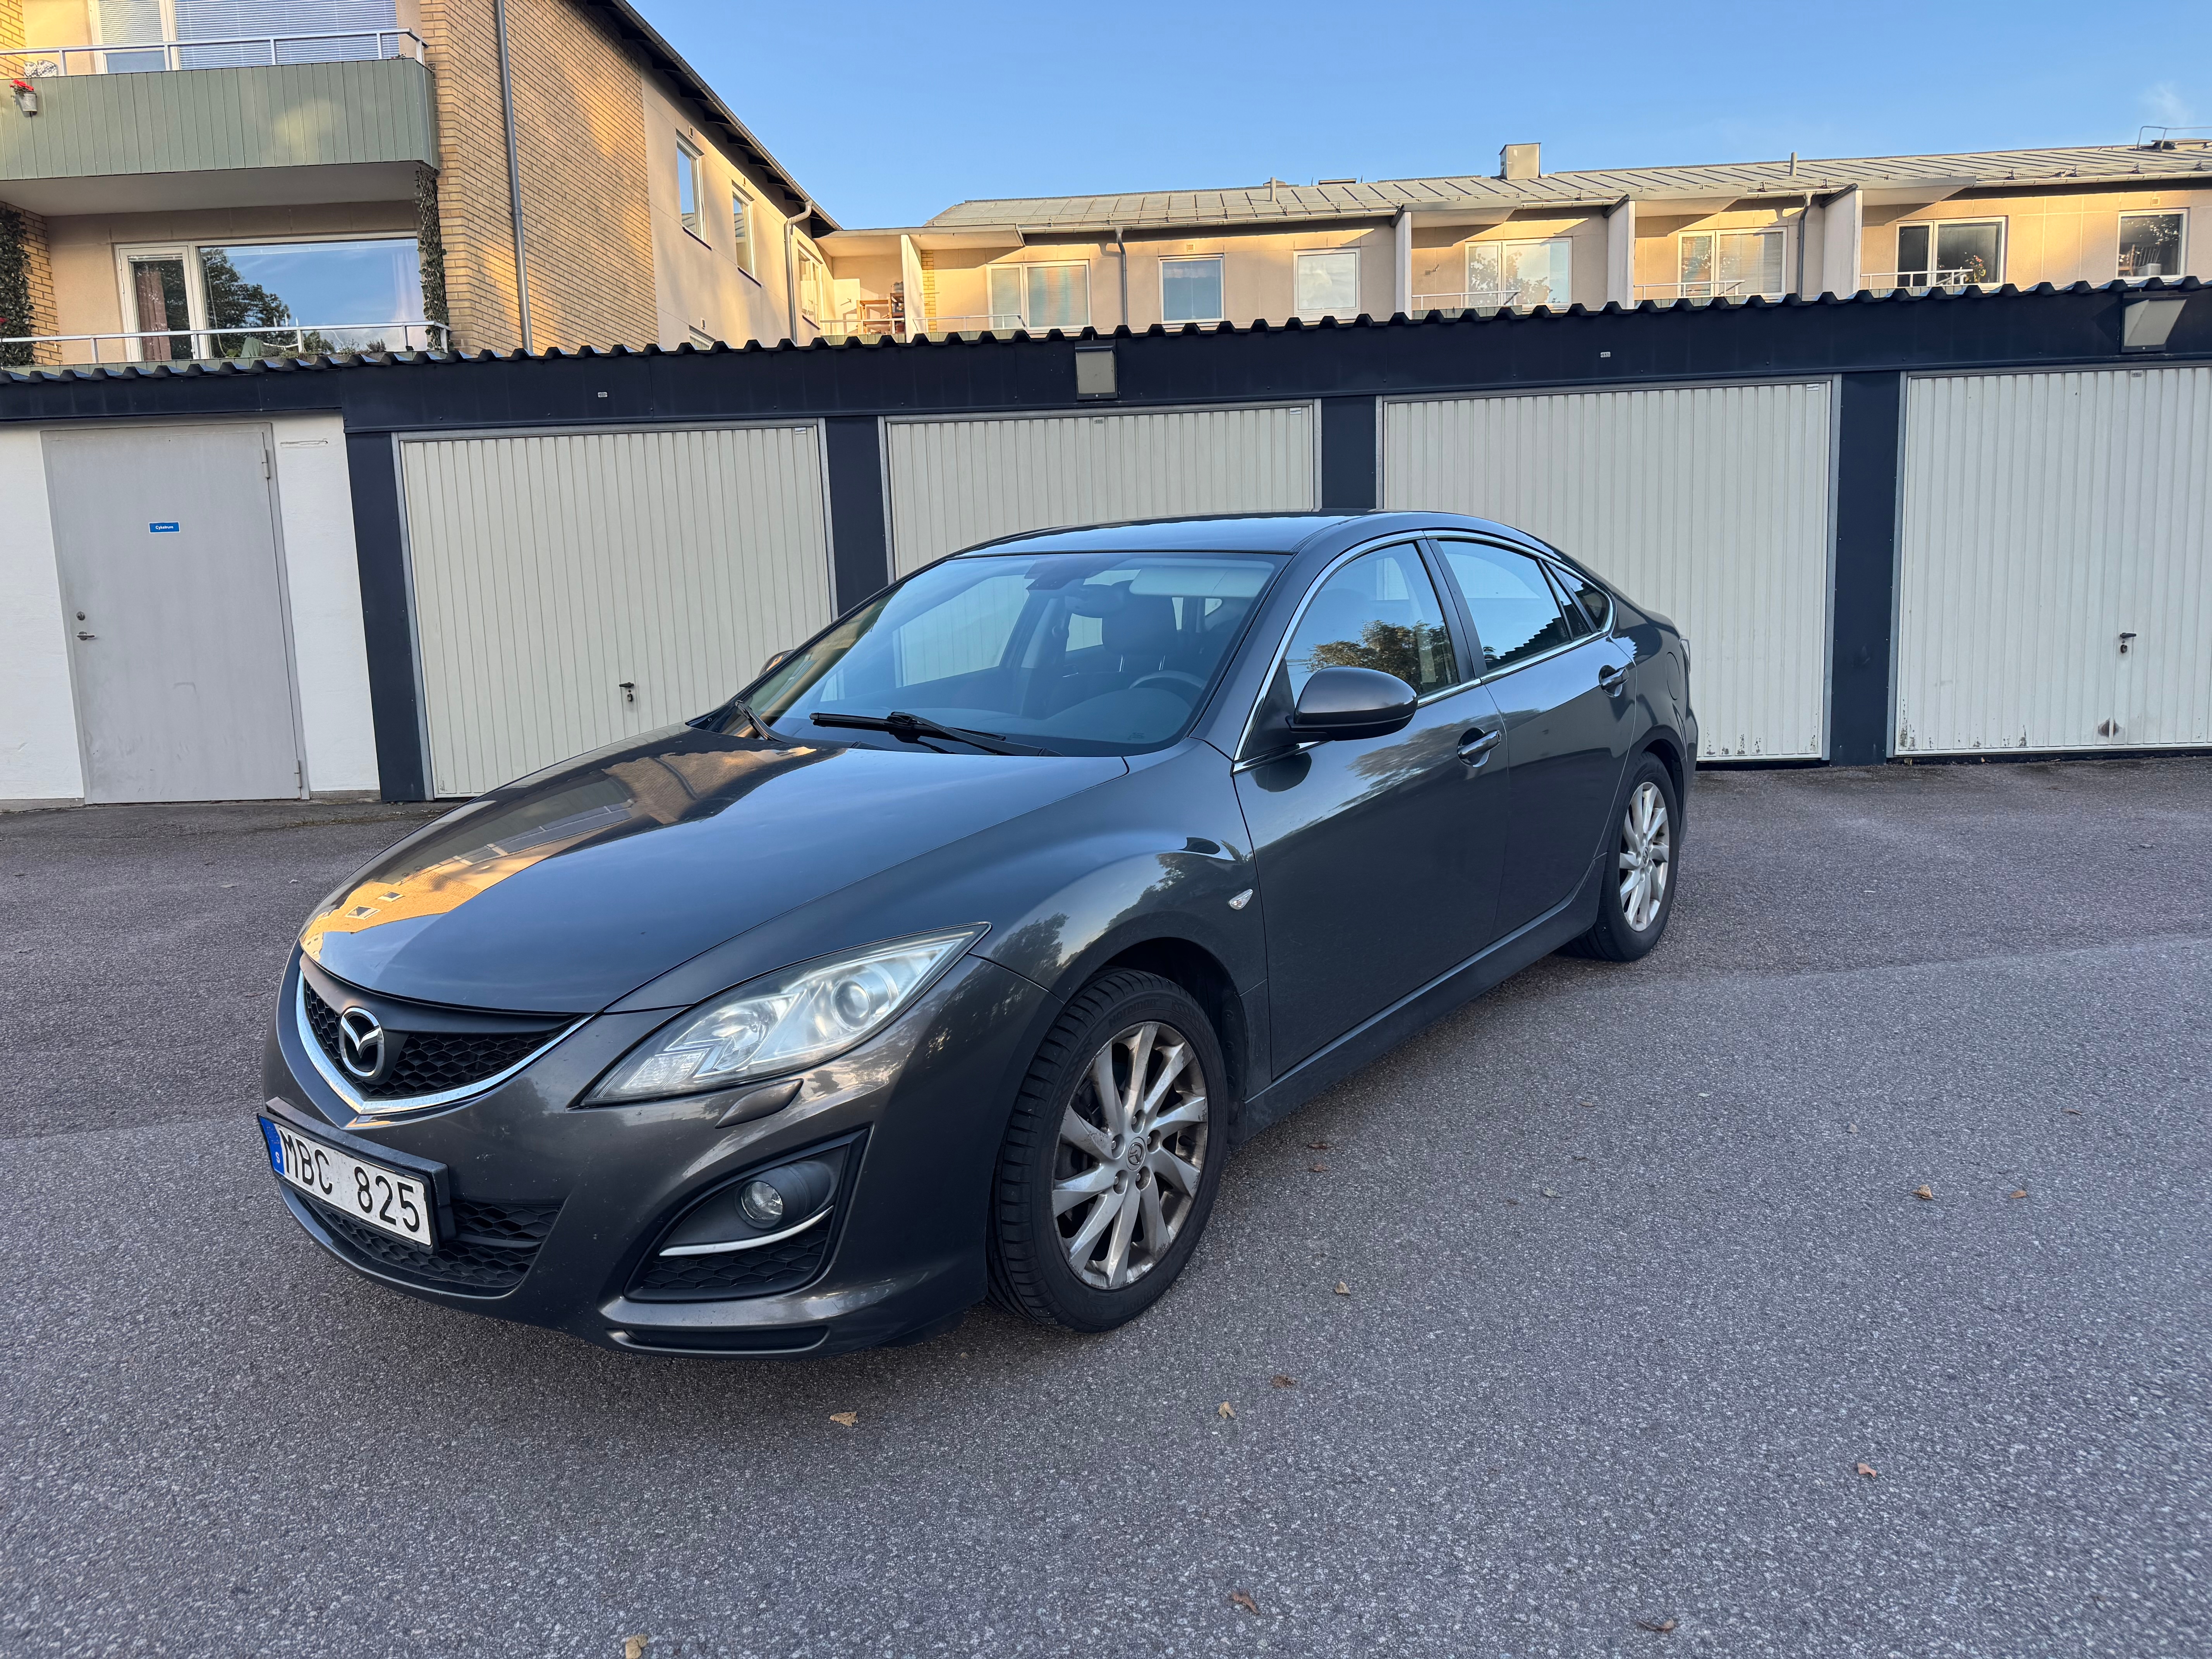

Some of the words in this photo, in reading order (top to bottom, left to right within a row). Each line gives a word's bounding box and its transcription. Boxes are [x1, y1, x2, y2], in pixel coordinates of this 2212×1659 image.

[275, 1151, 280, 1164] S
[280, 1129, 332, 1195] MBC
[354, 1166, 420, 1232] 825
